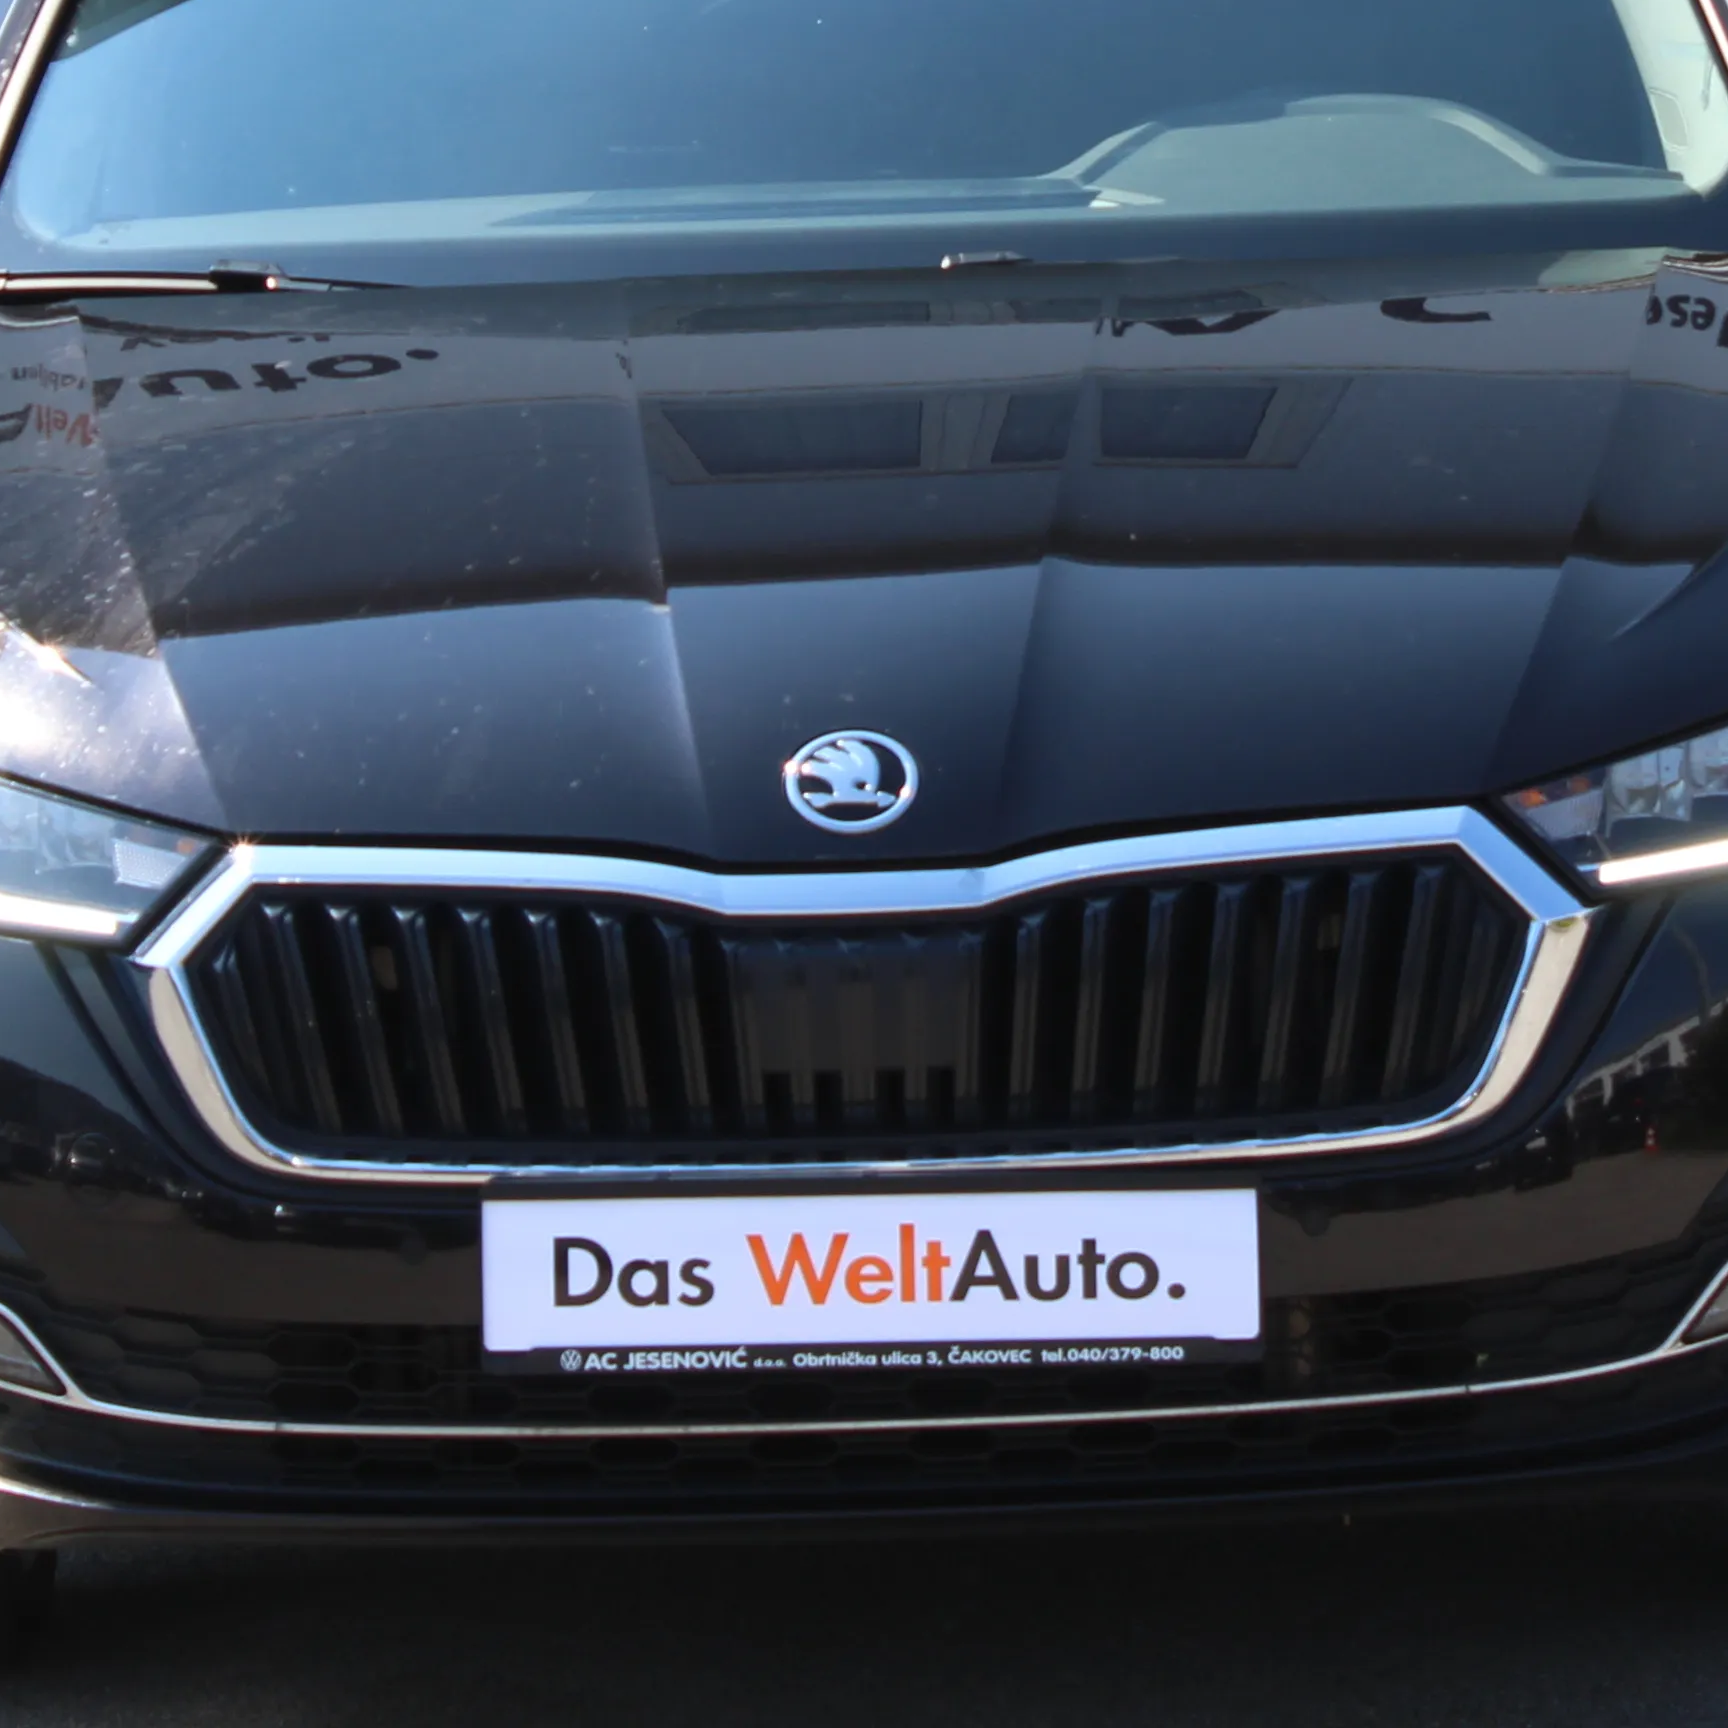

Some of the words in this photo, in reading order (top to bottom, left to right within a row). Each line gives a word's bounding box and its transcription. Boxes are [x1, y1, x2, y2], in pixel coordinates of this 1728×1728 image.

[553, 1237, 714, 1307] Das
[747, 1223, 1186, 1306] WeltAuto.
[584, 1352, 618, 1371] AC
[623, 1346, 748, 1370] JESENOVIĆ
[792, 1350, 876, 1367] Obrtnička
[881, 1350, 922, 1366] ulica
[925, 1351, 943, 1367] 3,
[947, 1345, 1032, 1365] ČAKOVEC
